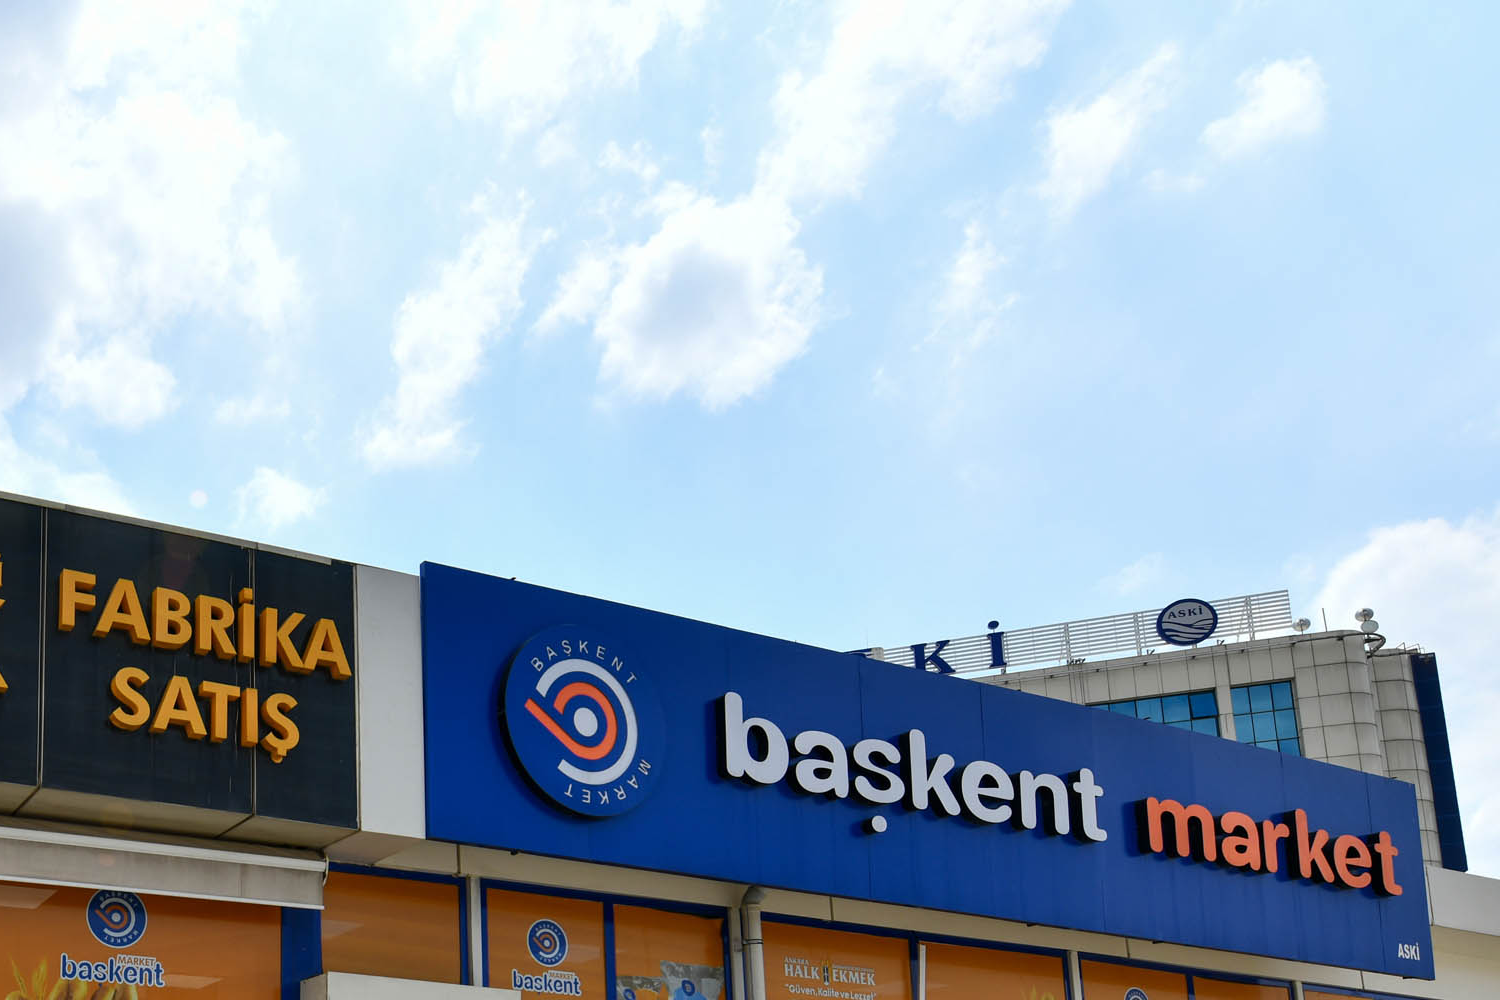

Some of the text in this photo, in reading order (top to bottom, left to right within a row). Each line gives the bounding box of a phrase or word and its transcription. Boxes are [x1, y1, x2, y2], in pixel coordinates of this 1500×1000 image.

[58, 569, 352, 680] FABRİKA
[1167, 605, 1204, 620] ASKİ
[530, 640, 637, 685] BAŞKENT
[109, 667, 300, 764] SATIŞ
[564, 759, 652, 804] MARKET
[722, 691, 1404, 897] başkent market
[118, 956, 155, 967] MARKET
[1398, 942, 1420, 960] ASKİ
[784, 963, 820, 979] HALK
[832, 968, 876, 986] EKMEK
